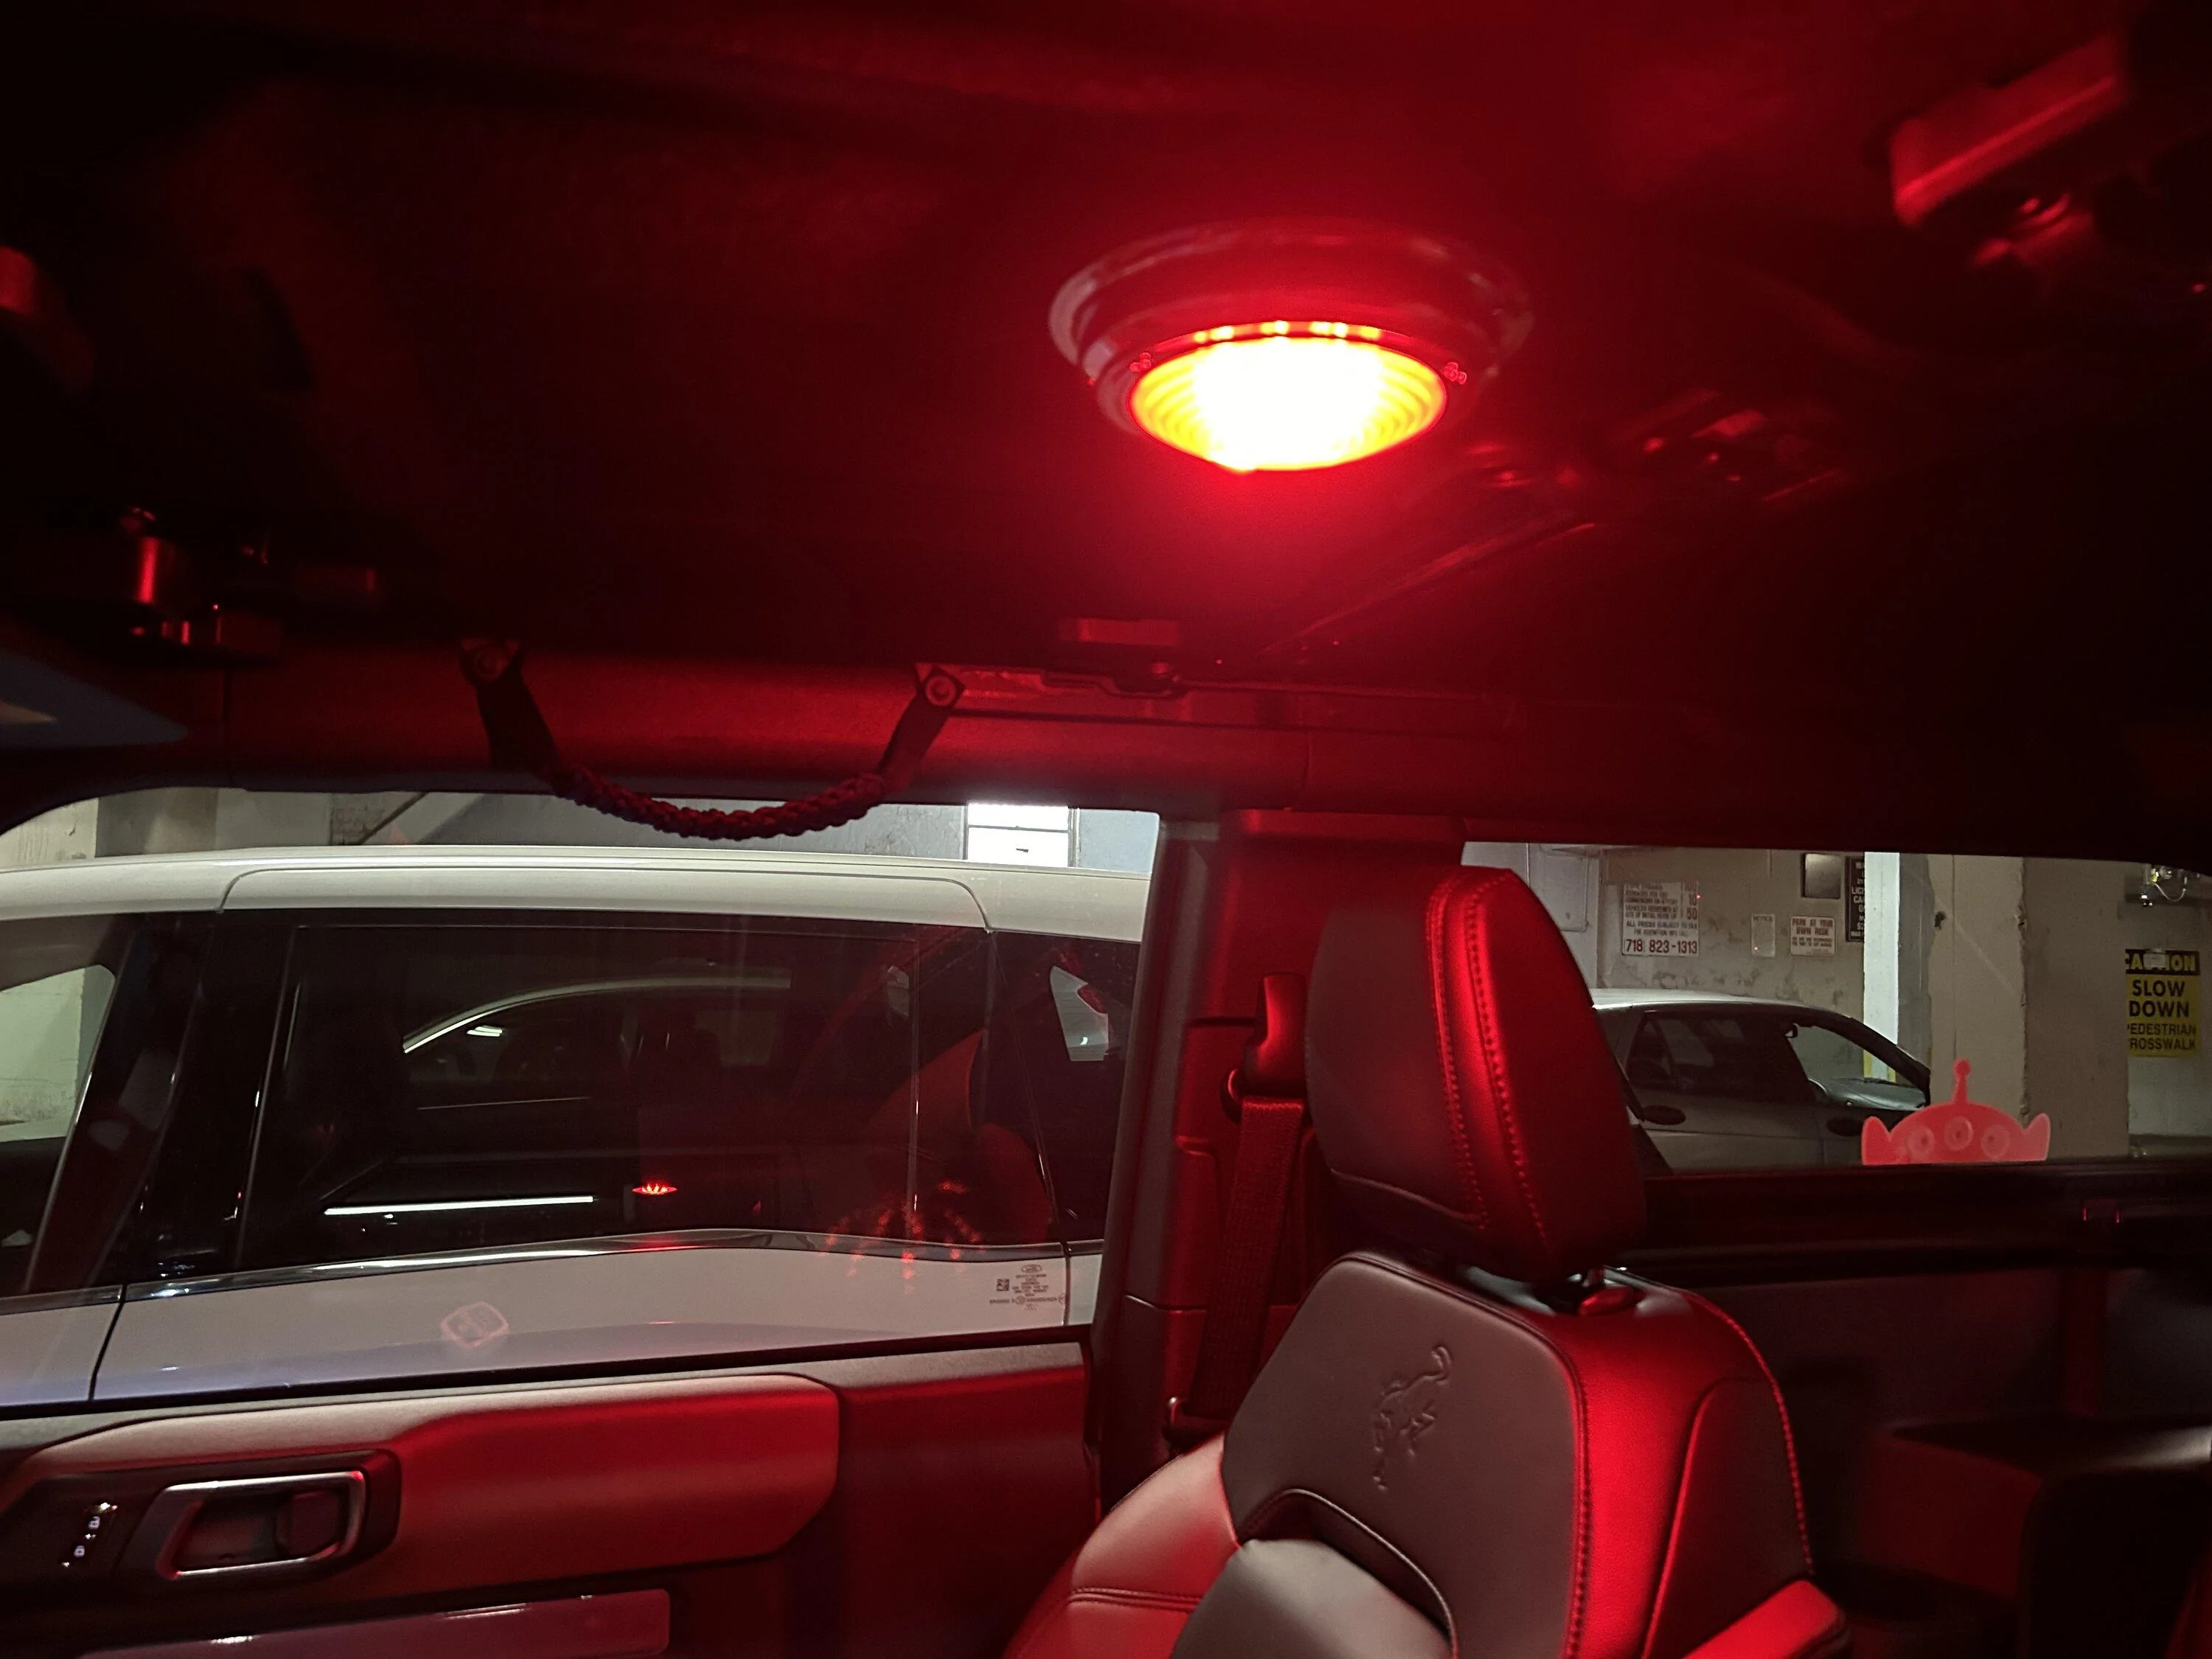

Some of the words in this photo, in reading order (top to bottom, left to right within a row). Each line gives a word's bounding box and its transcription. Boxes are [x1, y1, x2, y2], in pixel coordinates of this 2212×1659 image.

[1686, 908, 1697, 919] 50
[1625, 939, 1644, 952] 718
[2132, 979, 2185, 997] SLOW
[2129, 1000, 2190, 1018] DOWN
[2127, 1023, 2197, 1036] EDESTRIAN
[2128, 1037, 2197, 1051] ROSSWALK
